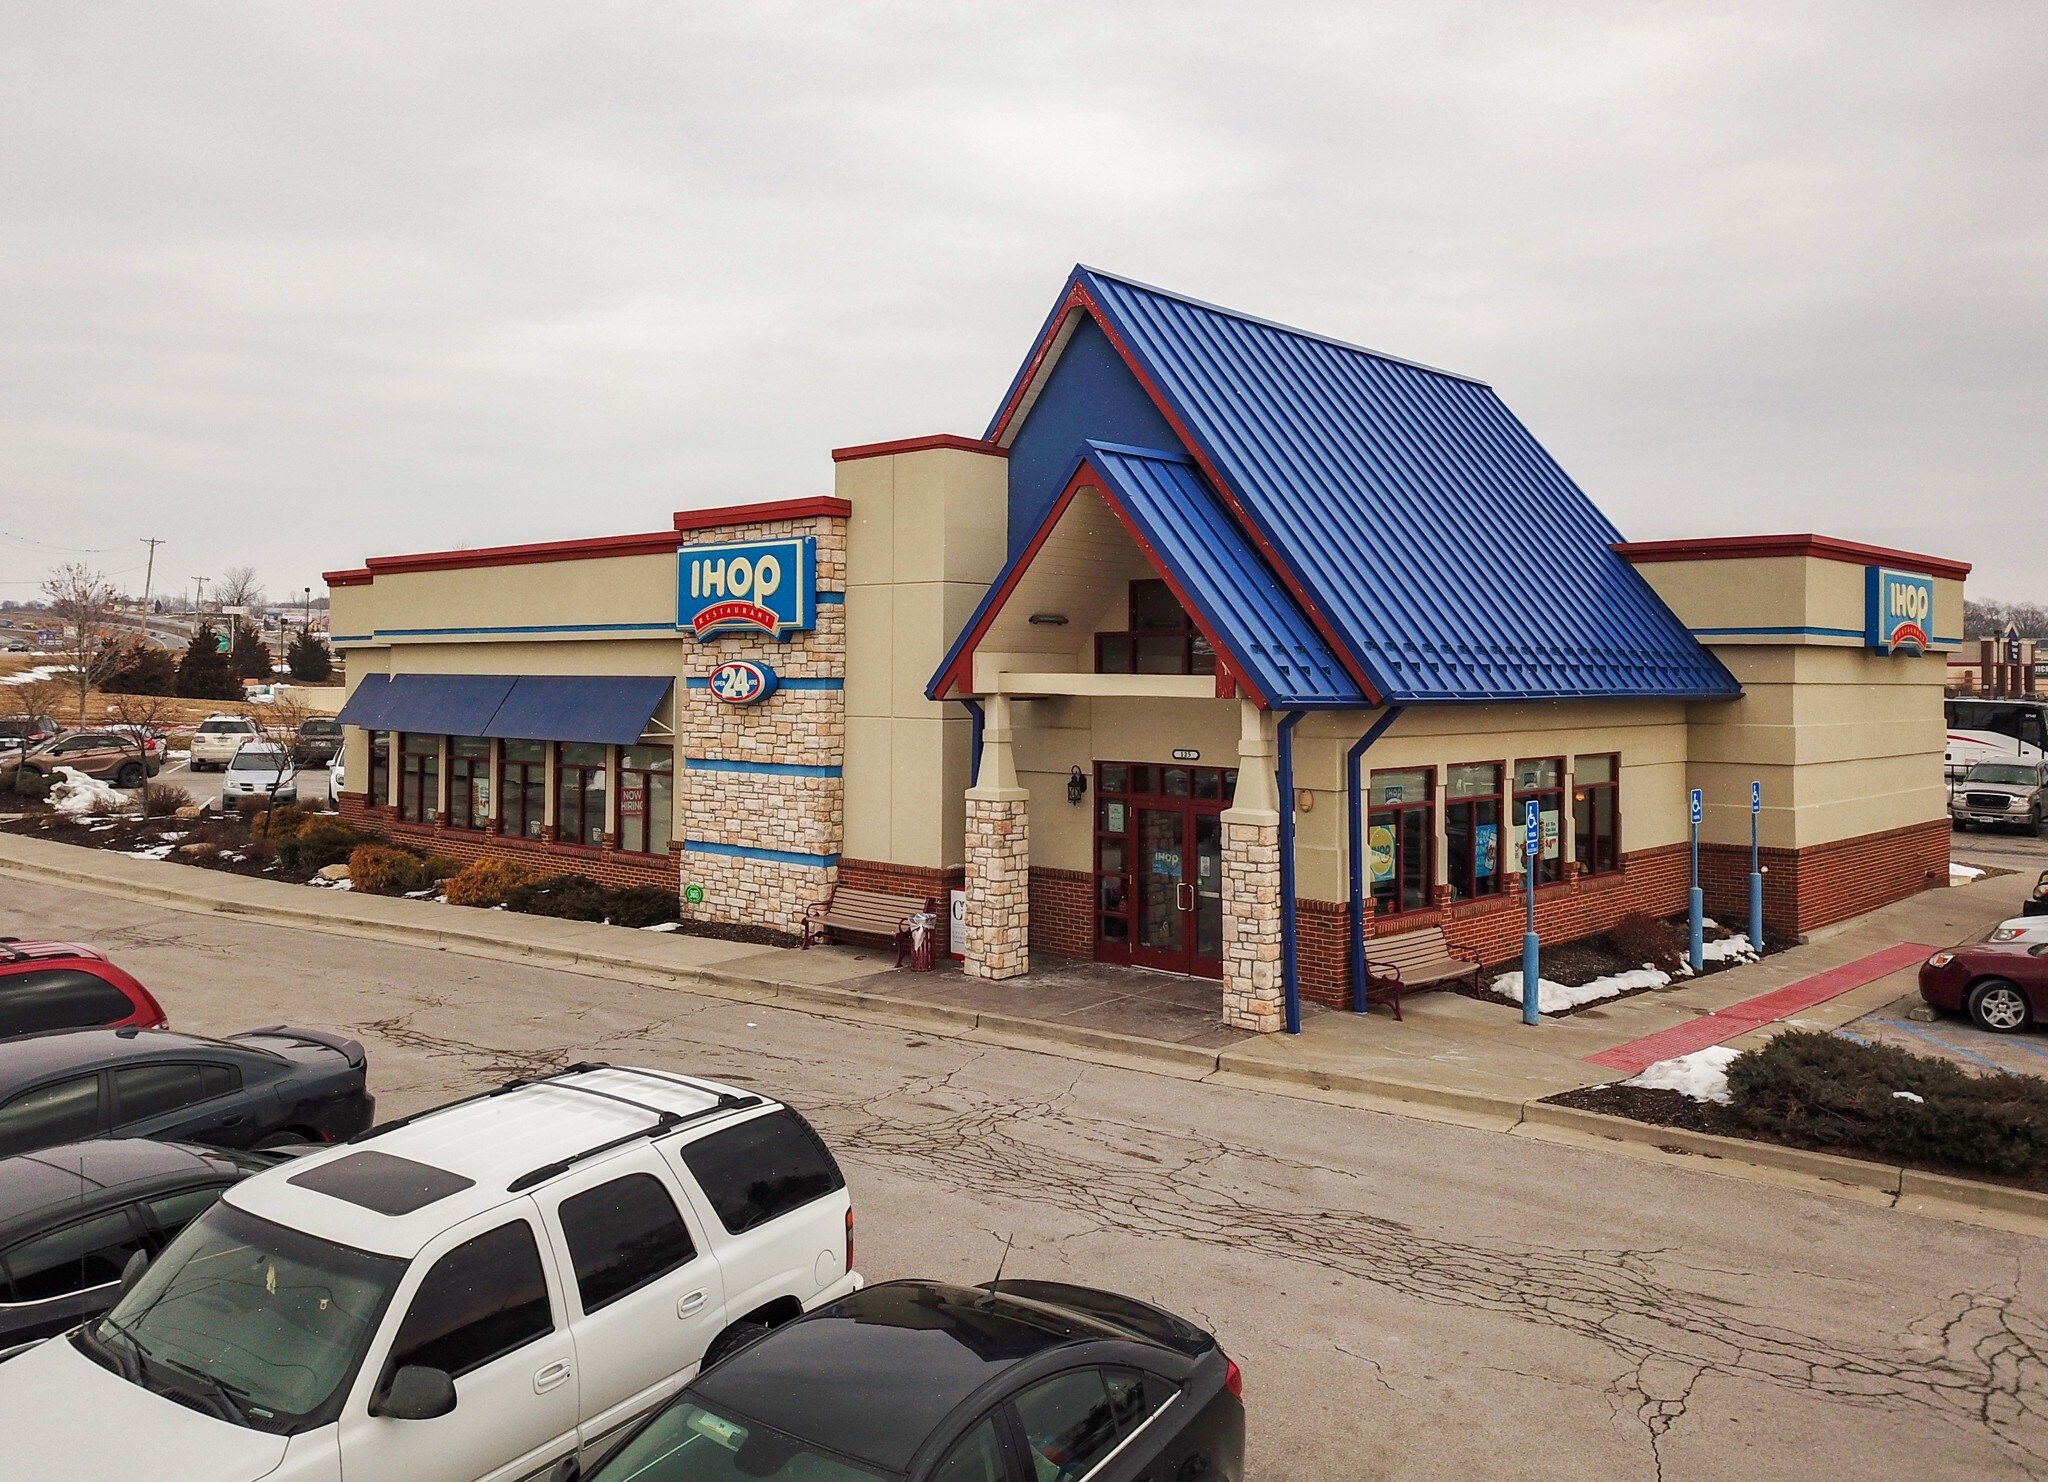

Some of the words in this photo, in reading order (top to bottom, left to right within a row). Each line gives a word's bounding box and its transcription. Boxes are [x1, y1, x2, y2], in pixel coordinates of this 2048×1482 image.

[691, 555, 781, 609] IHOP
[698, 605, 770, 626] RESTAURANT
[1891, 583, 1928, 630] IHOP
[722, 666, 750, 698] 24
[623, 790, 642, 800] NOW
[1386, 787, 1402, 799] IHOP
[1154, 852, 1179, 866] IHOP
